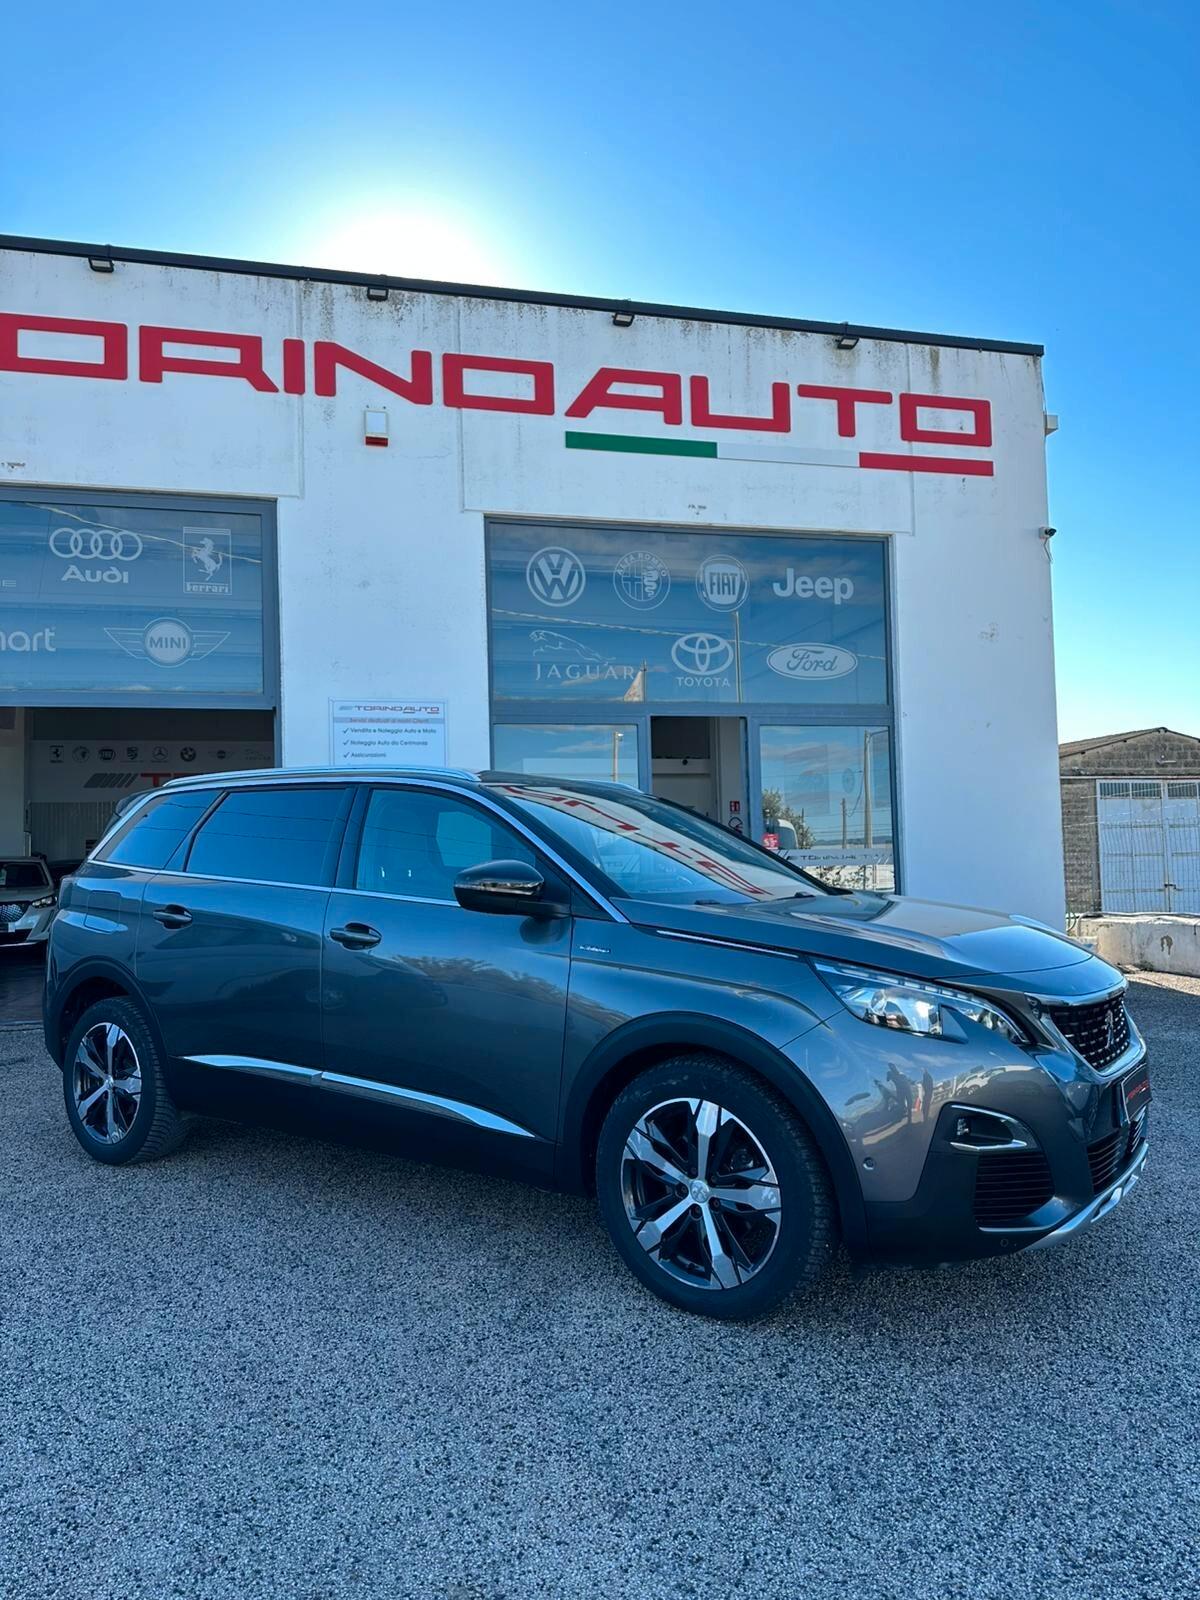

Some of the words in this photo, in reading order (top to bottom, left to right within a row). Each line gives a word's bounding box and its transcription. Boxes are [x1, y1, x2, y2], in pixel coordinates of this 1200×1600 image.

[61, 565, 129, 584] Audi
[638, 552, 667, 577] ROMEO
[186, 582, 229, 593] Ferrari
[709, 571, 738, 596] FIAT
[772, 567, 854, 605] Jeep
[0, 627, 56, 652] art
[149, 636, 186, 649] MINI
[786, 648, 838, 671] Ford
[535, 663, 635, 681] JAGUAR
[676, 676, 731, 688] TOYOTA
